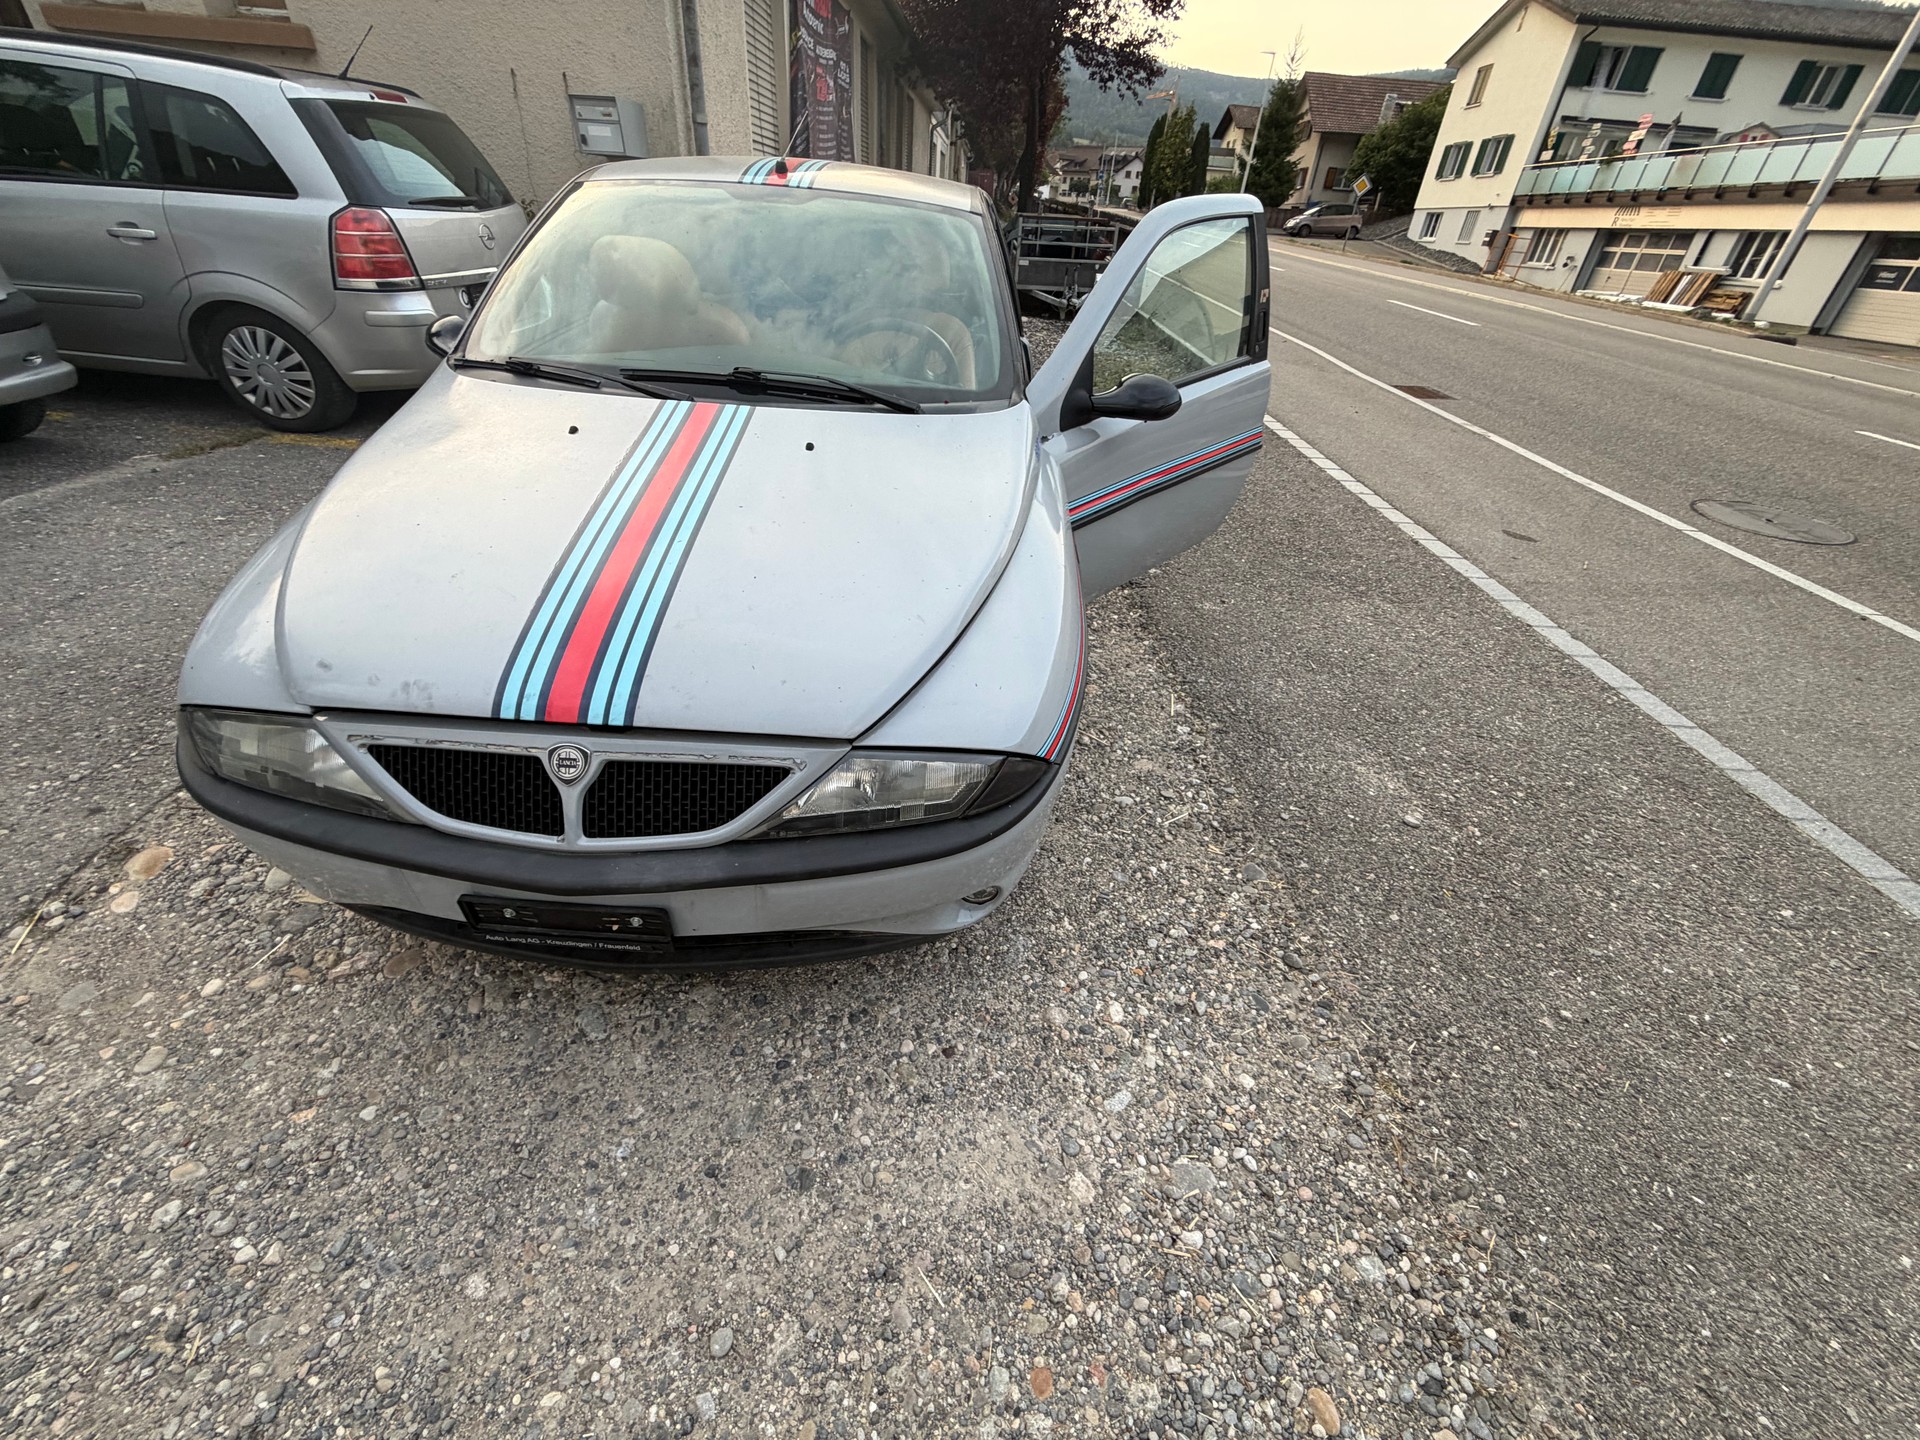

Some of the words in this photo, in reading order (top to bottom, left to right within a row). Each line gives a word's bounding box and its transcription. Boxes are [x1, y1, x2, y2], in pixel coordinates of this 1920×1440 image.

[505, 935, 526, 944] Lang
[546, 939, 593, 948] Kreuzlingen
[598, 942, 641, 951] Frauenfeld
